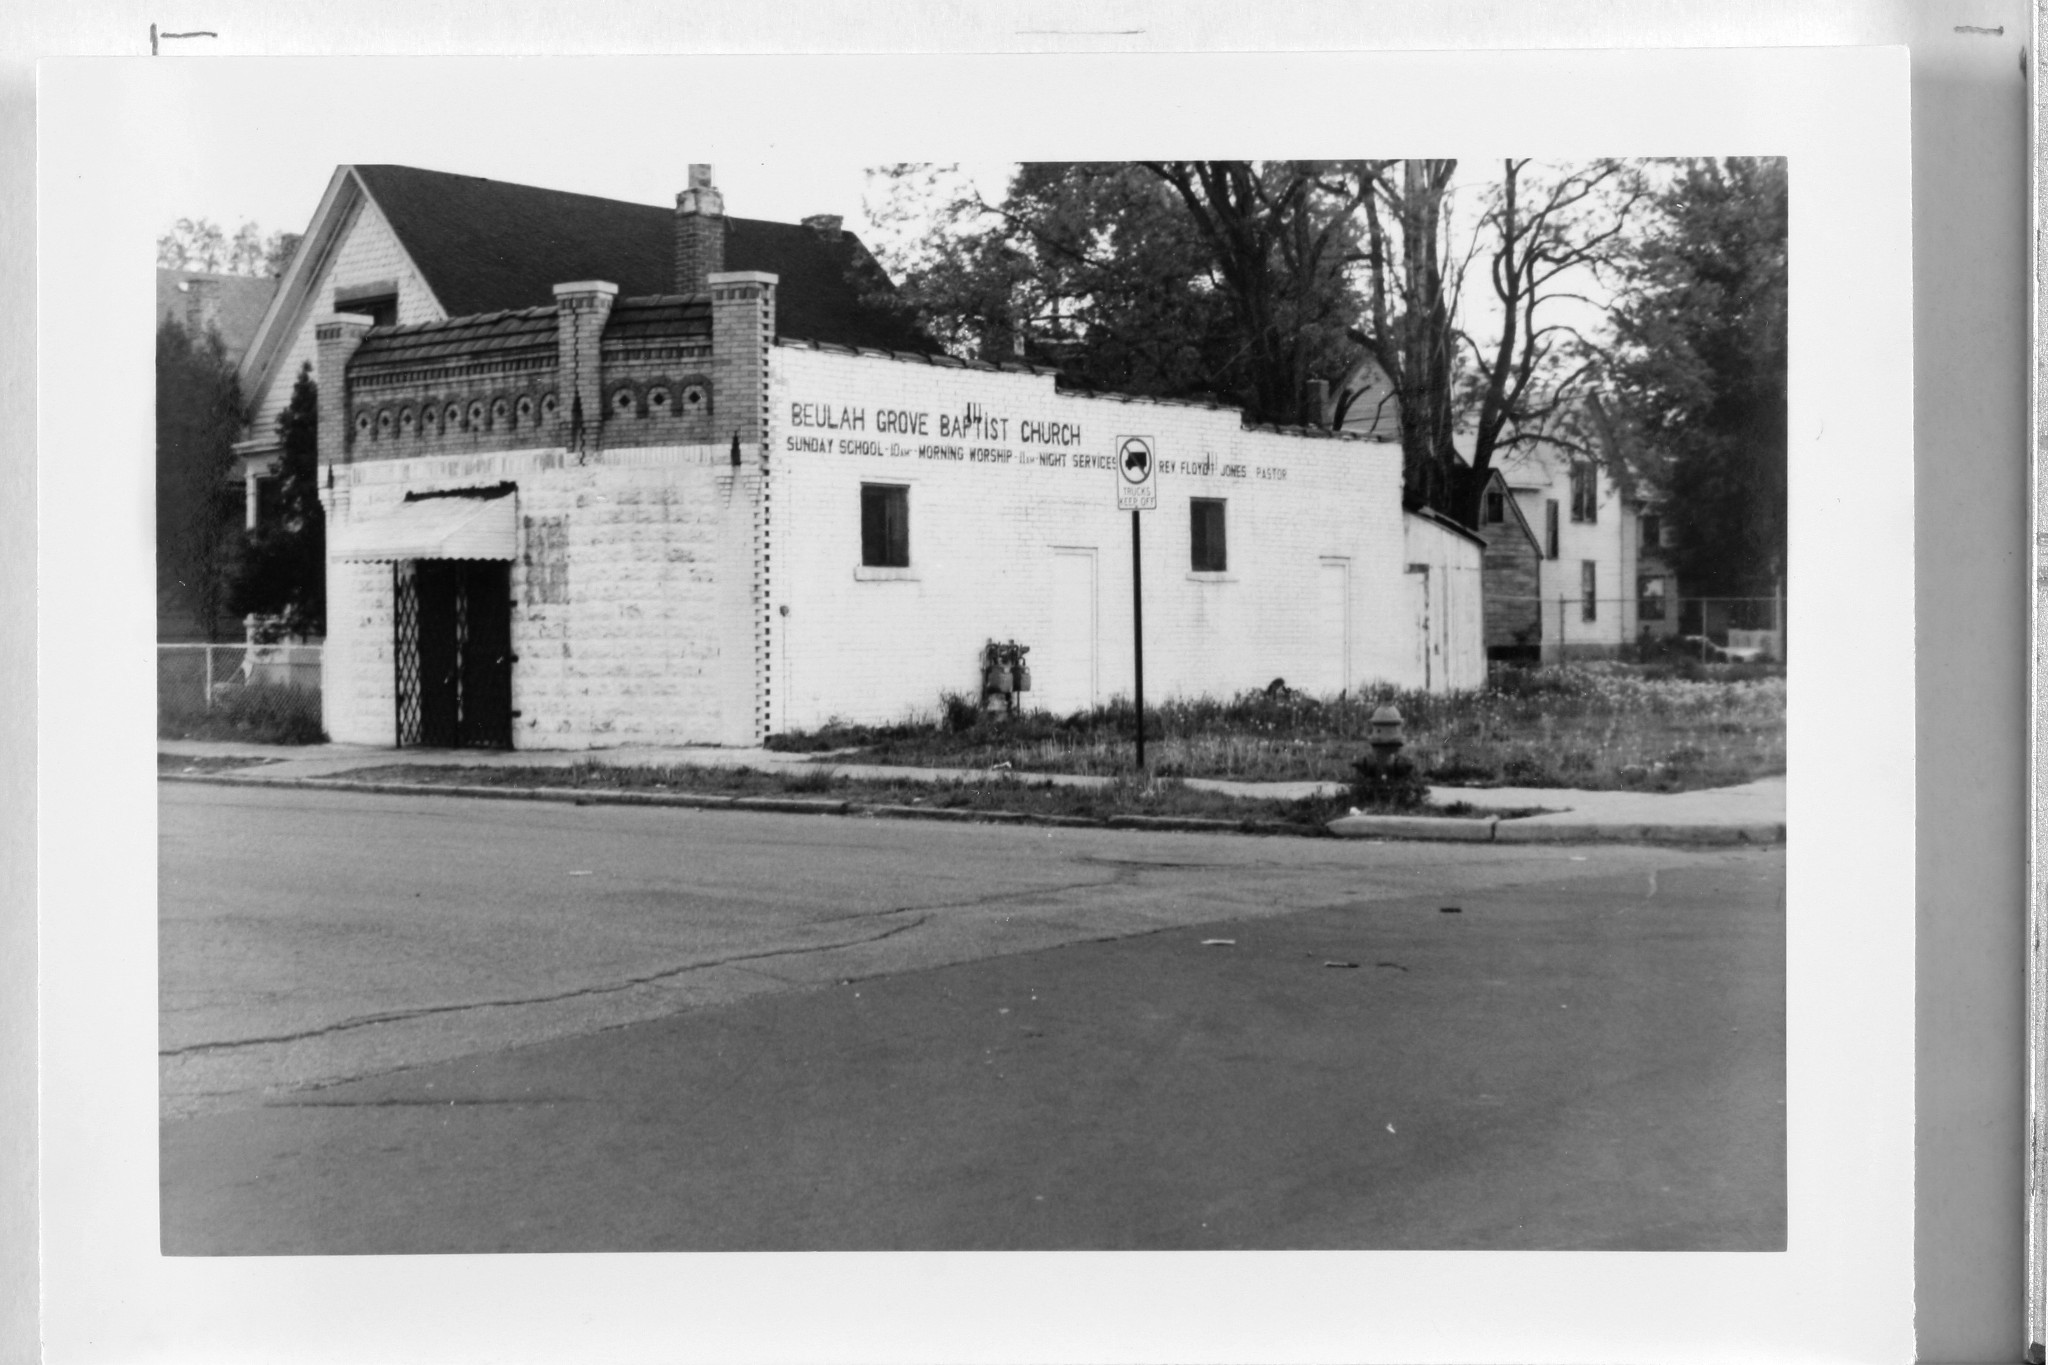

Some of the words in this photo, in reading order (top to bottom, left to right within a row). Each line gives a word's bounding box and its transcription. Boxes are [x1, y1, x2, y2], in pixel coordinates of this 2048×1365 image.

[792, 402, 865, 432] BEULAH
[876, 409, 929, 436] GROVE
[940, 412, 1008, 441] BAPTIST
[1021, 420, 1081, 447] CHURCH
[787, 436, 833, 454] SUNDAY
[1073, 454, 1117, 470] SERVICES
[1159, 460, 1176, 474] REV
[1220, 464, 1247, 478] JONES
[1256, 467, 1287, 481] PASTOR
[1120, 496, 1138, 506] KEEP
[1123, 486, 1151, 497] TRUCKS
